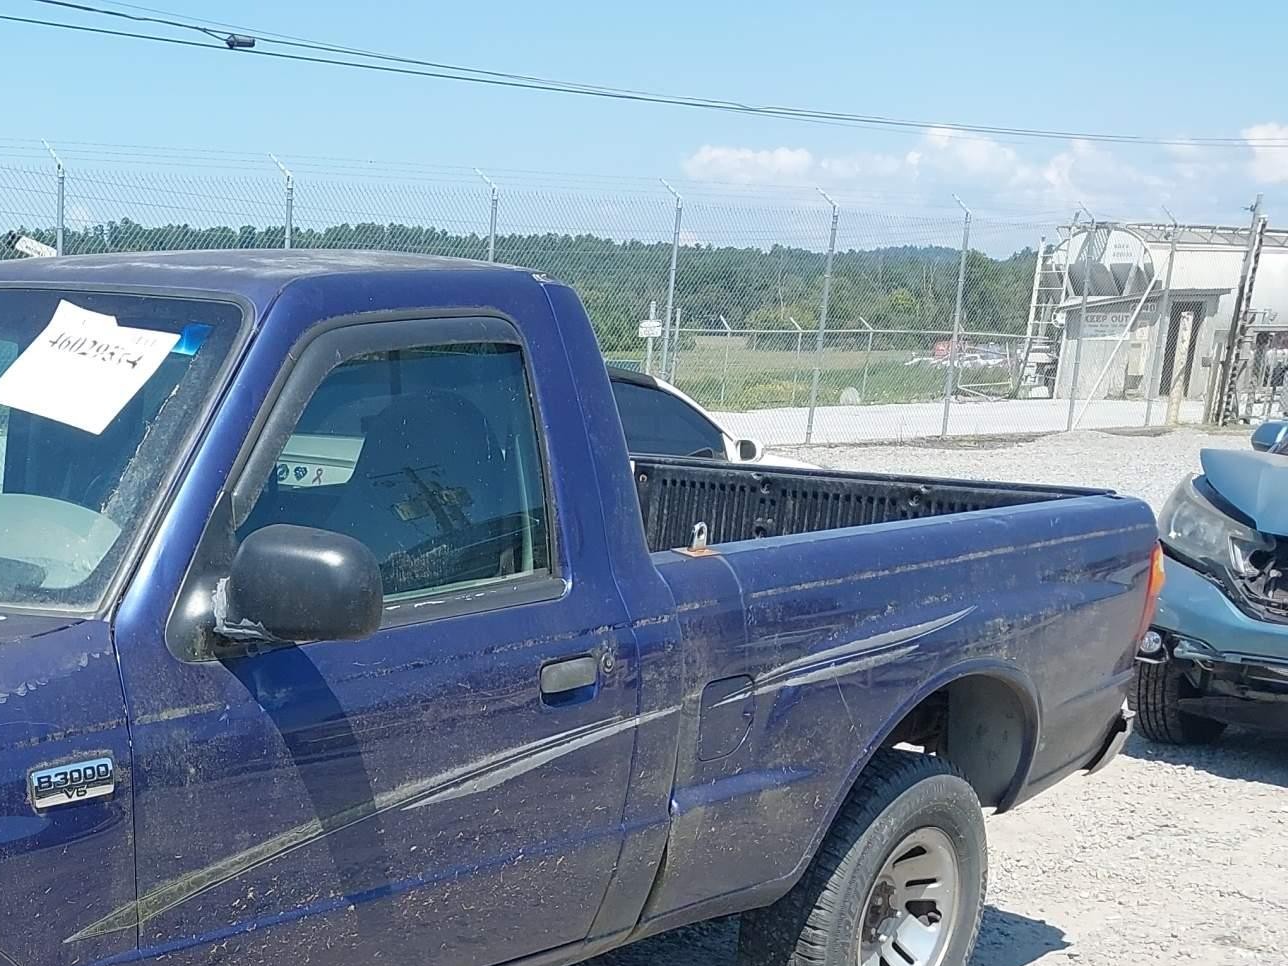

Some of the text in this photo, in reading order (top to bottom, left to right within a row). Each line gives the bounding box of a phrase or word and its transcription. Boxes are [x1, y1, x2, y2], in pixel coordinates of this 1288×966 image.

[1111, 313, 1130, 323] OUT
[36, 763, 109, 790] B3000
[63, 785, 88, 800] V6
